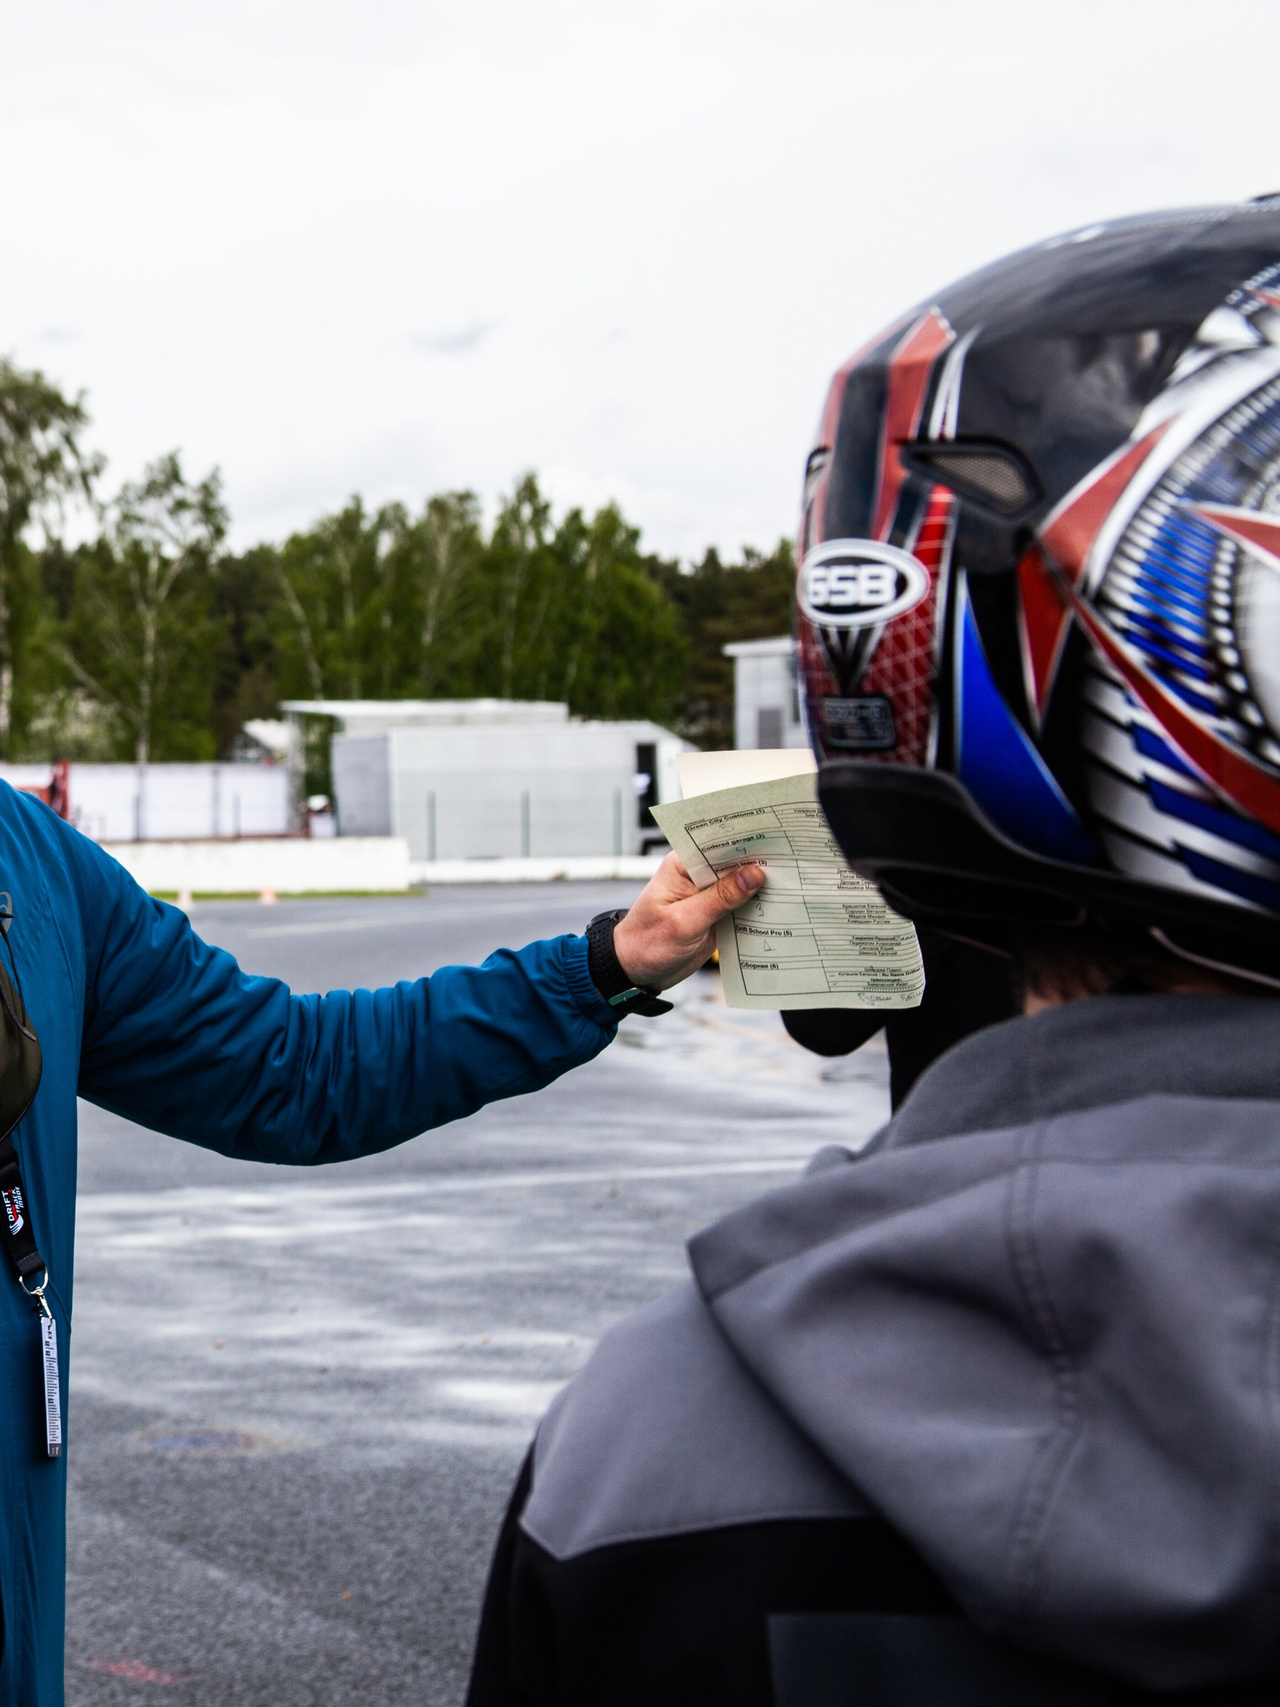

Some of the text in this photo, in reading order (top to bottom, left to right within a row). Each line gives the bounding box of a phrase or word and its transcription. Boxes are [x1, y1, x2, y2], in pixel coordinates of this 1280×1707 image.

[687, 820, 708, 831] Green
[724, 811, 754, 820] Customs
[731, 836, 754, 845] garage
[756, 902, 765, 917] 3
[749, 928, 769, 936] School
[1, 1190, 15, 1222] DRIFT
